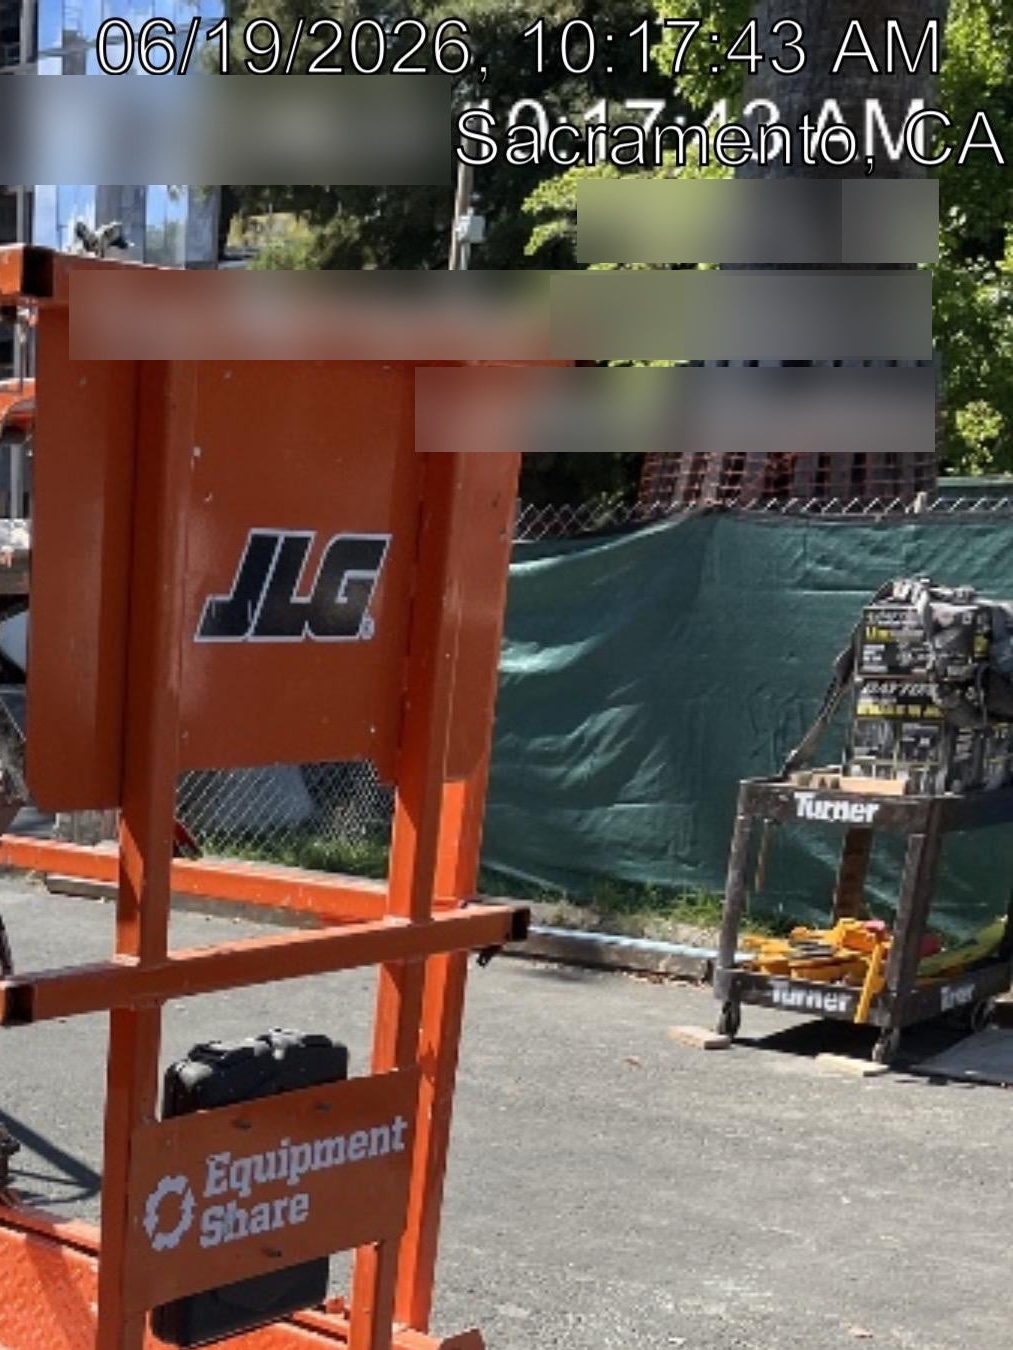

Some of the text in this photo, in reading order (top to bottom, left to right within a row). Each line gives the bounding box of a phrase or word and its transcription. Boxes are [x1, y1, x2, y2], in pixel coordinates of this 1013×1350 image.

[194, 528, 392, 643] JLG
[794, 791, 880, 824] Turner
[203, 1115, 409, 1198] Equipment
[199, 1193, 310, 1249] Share
